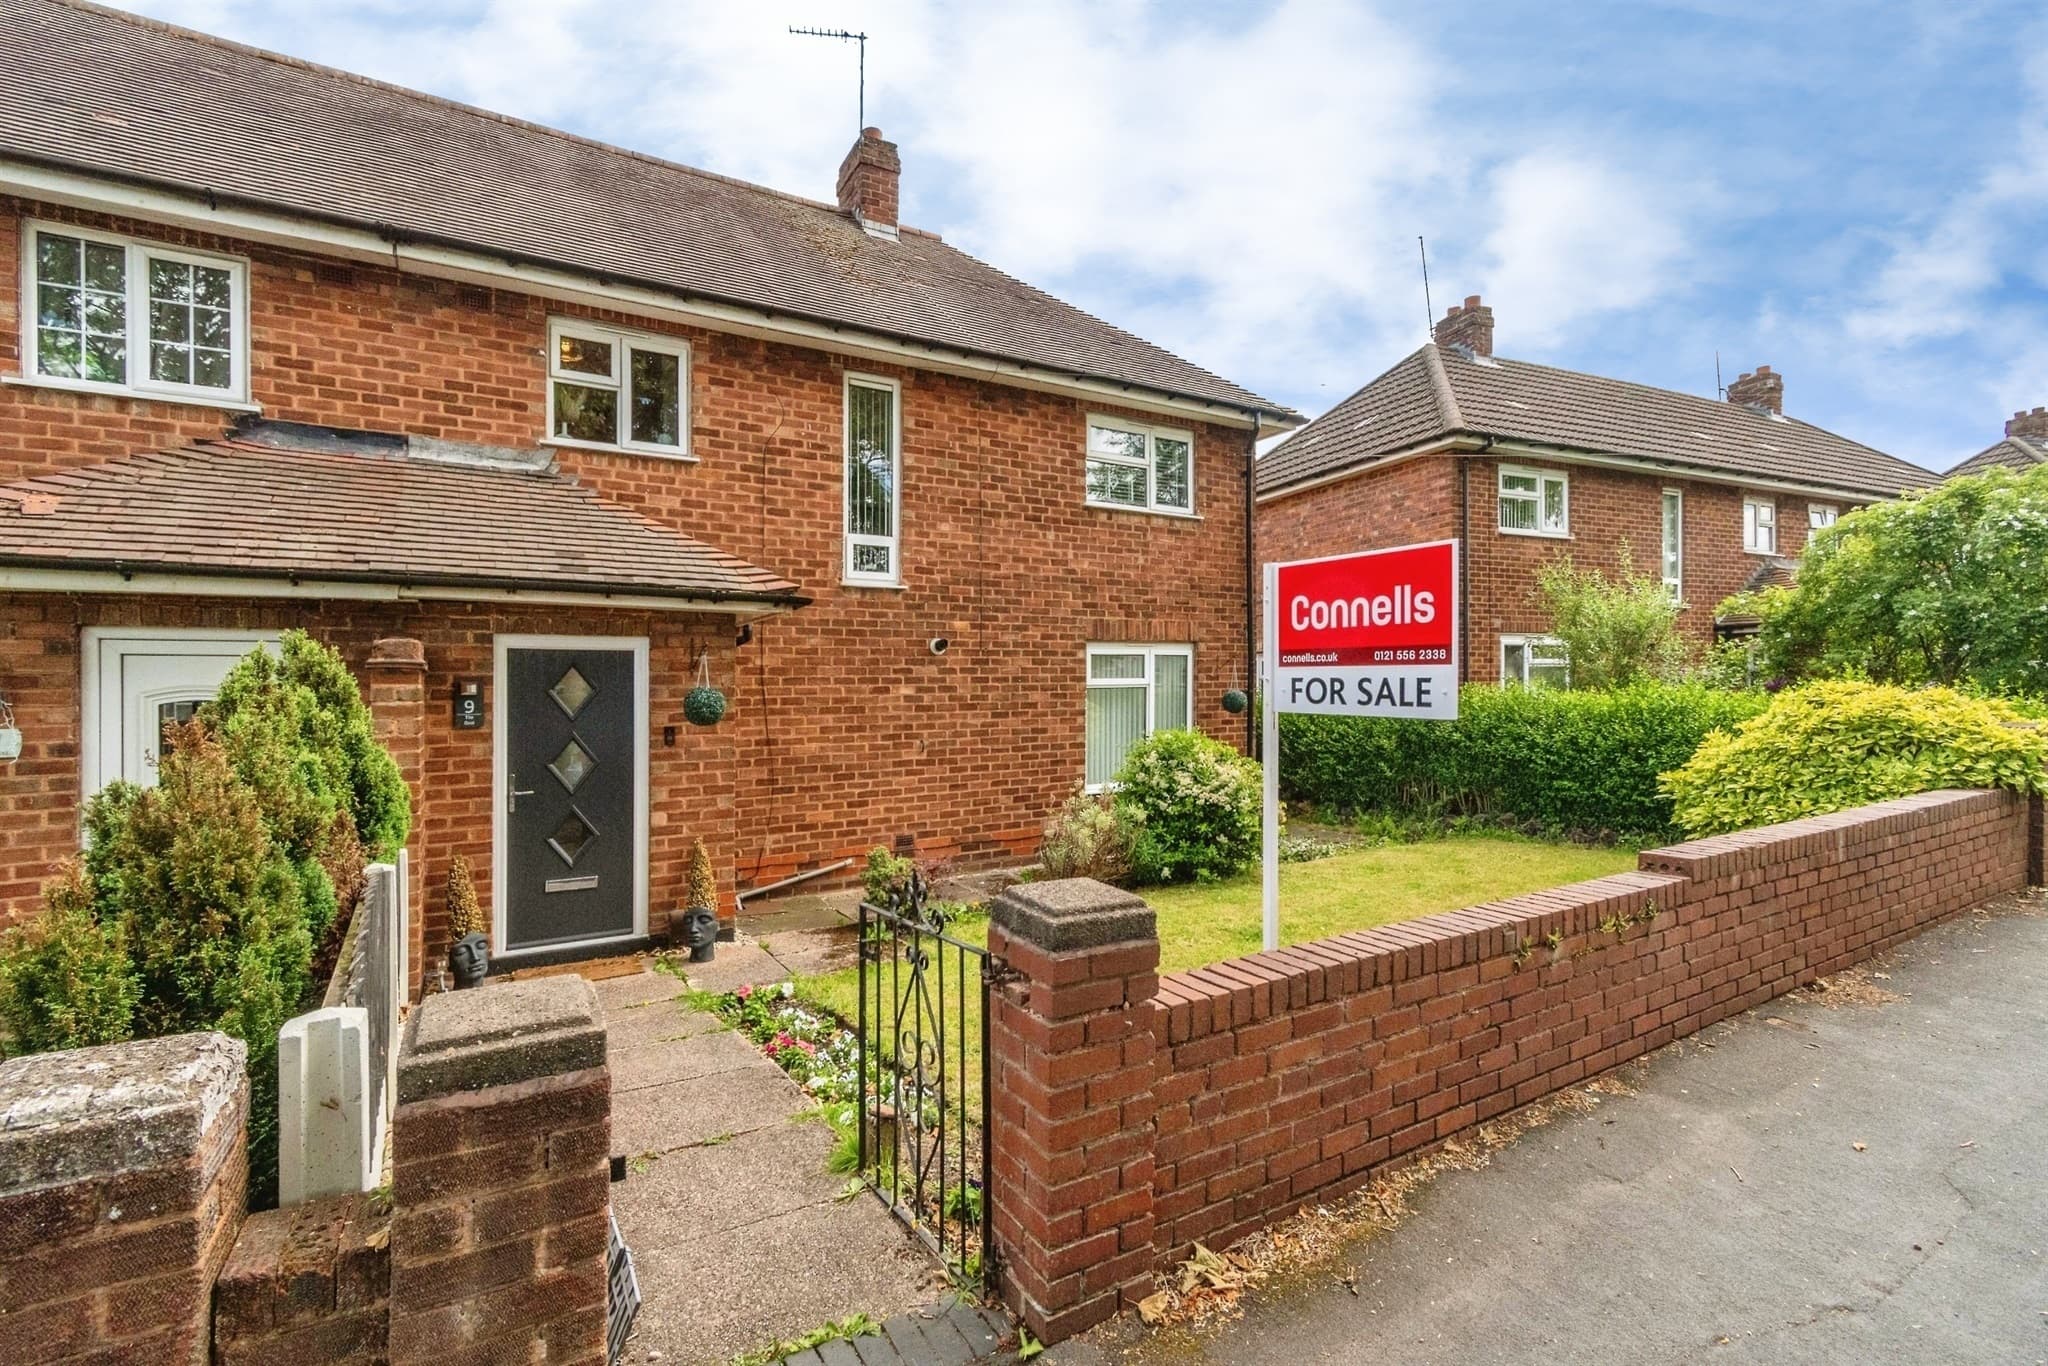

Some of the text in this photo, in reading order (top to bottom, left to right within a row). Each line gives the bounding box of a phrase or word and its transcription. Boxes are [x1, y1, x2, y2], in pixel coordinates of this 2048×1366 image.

[1291, 584, 1435, 631] Connells
[1282, 652, 1338, 663] connells.co.uk
[1374, 649, 1447, 661] 0121 556 2338
[1291, 677, 1432, 707] FOR SALE
[464, 700, 475, 714] 9
